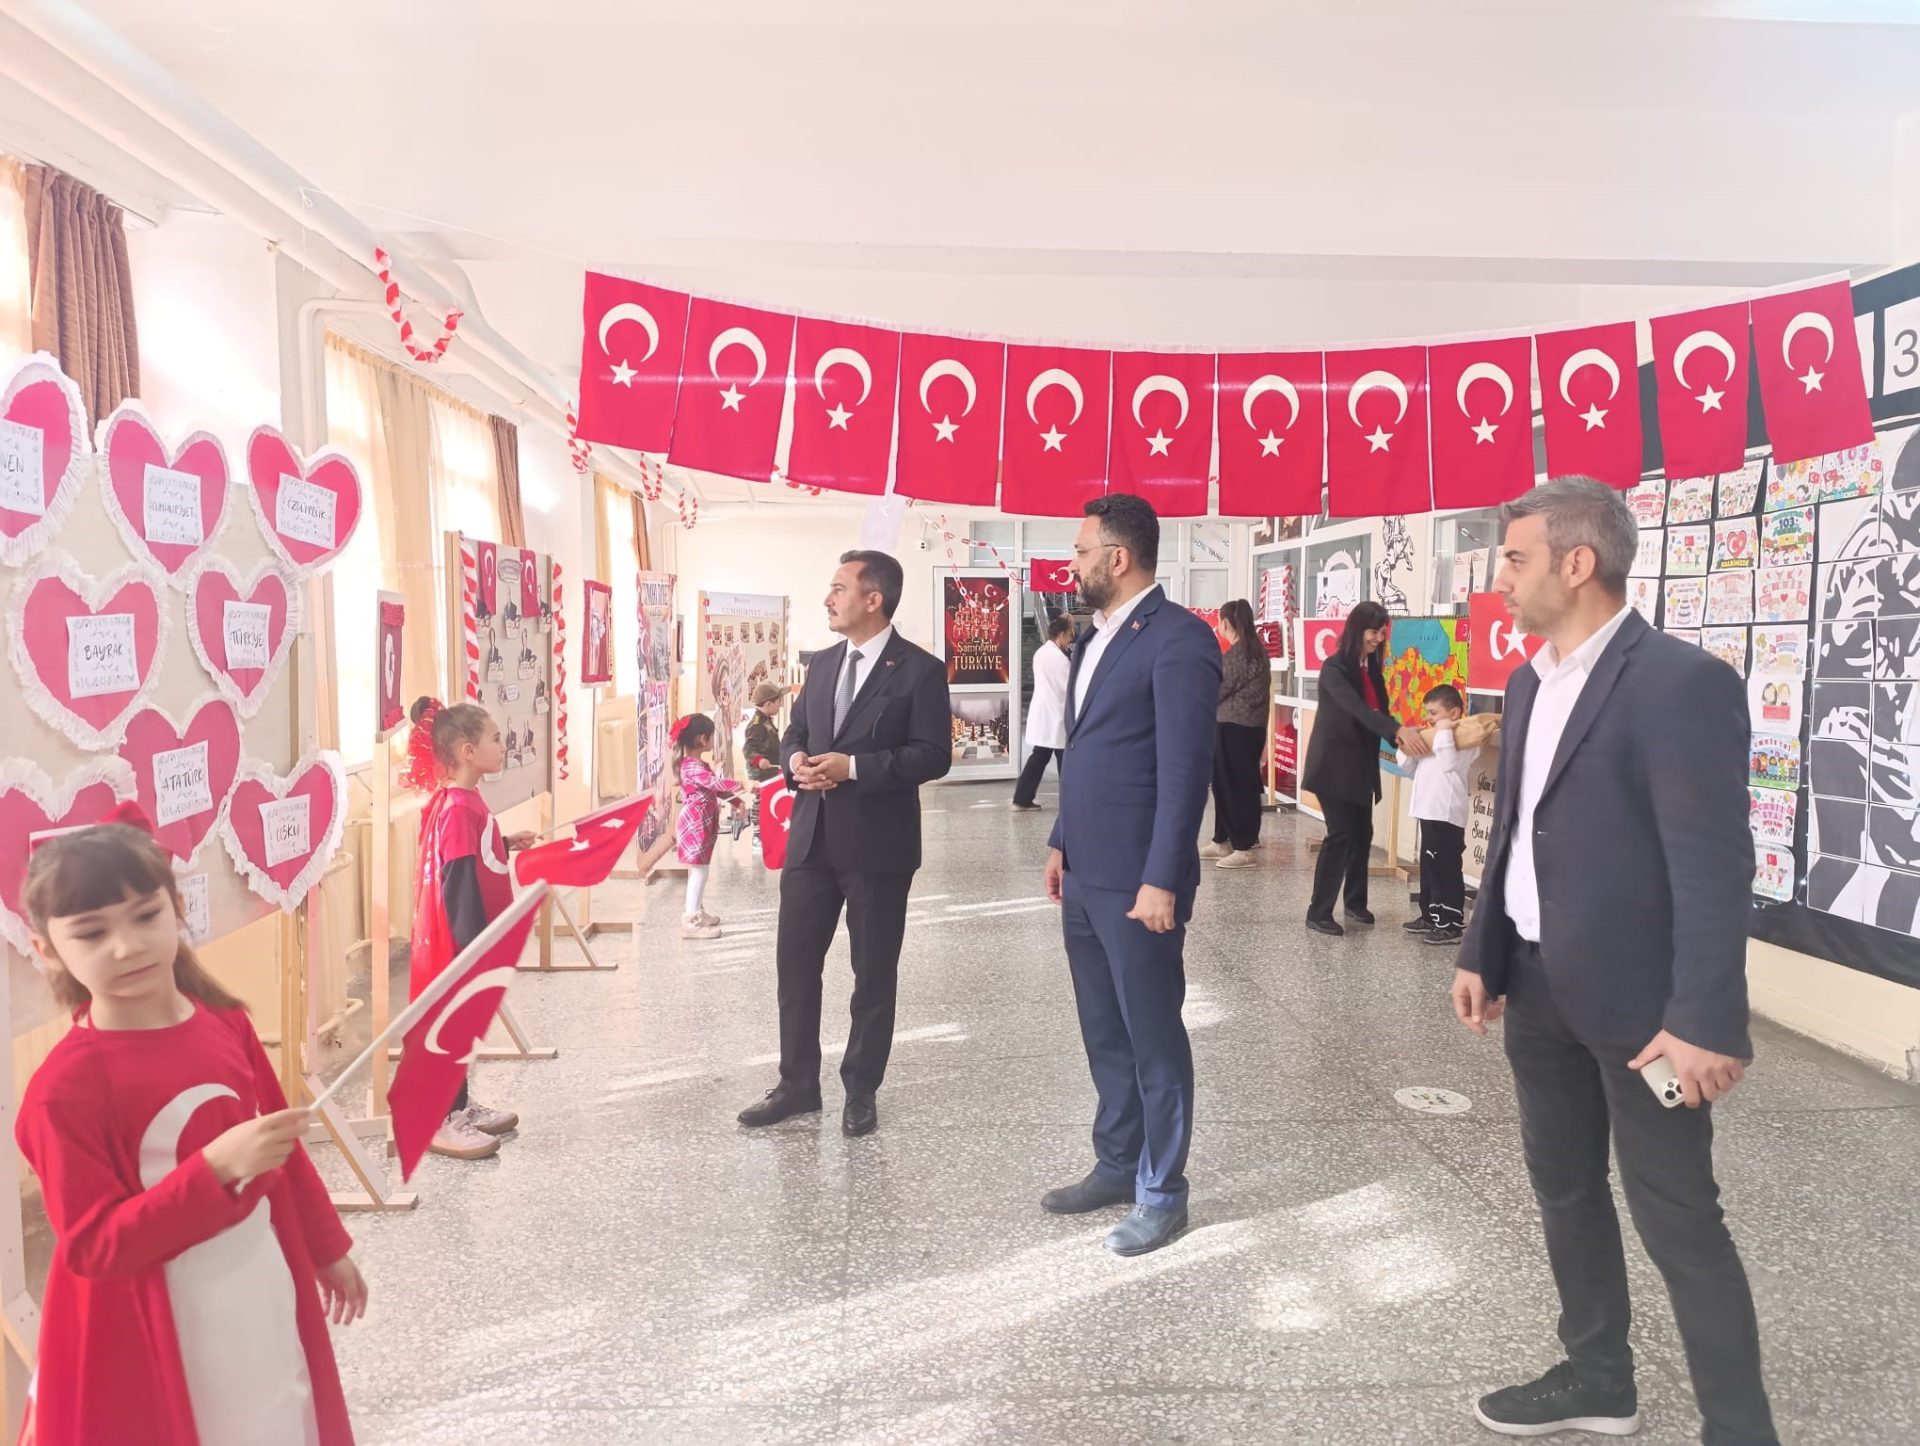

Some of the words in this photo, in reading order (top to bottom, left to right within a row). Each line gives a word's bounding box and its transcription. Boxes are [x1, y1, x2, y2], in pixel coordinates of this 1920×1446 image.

[83, 643, 124, 662] BAYRAK
[952, 652, 1002, 671] TÜRKİYE
[161, 768, 204, 792] ATATÜRK
